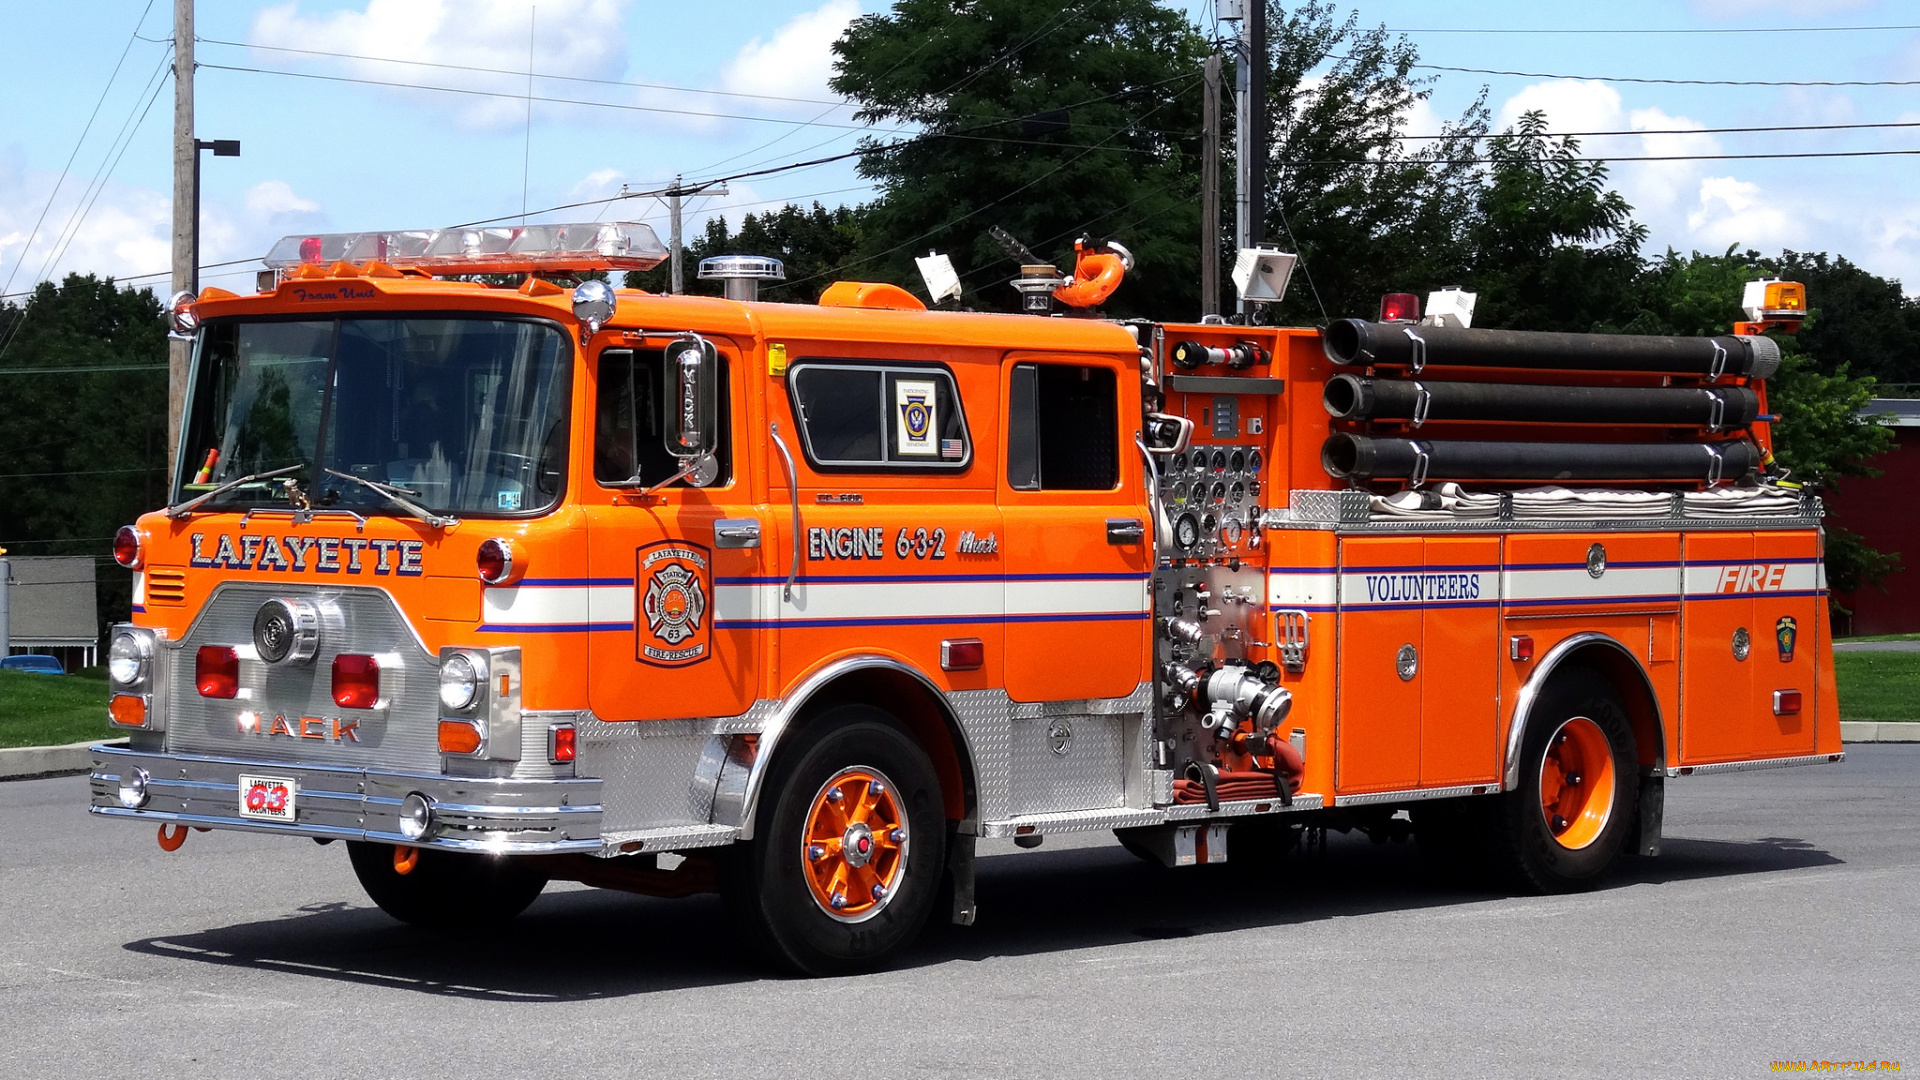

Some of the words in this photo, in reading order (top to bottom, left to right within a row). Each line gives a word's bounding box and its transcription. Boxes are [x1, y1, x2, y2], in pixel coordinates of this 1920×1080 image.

[293, 288, 338, 301] Foam
[338, 287, 376, 299] Unit
[808, 527, 884, 560] ENGINE
[956, 530, 999, 554] Mack
[190, 532, 424, 577] LAFAYETTE
[652, 549, 697, 560] LAFAYETTE
[662, 571, 688, 580] STATION
[1717, 564, 1786, 594] FIRE
[1365, 573, 1480, 602] VOLUNTEERS
[667, 629, 680, 639] 63
[250, 780, 284, 789] LAFAYETTE
[246, 783, 288, 810] 63
[248, 806, 286, 816] VOLUNTEERS
